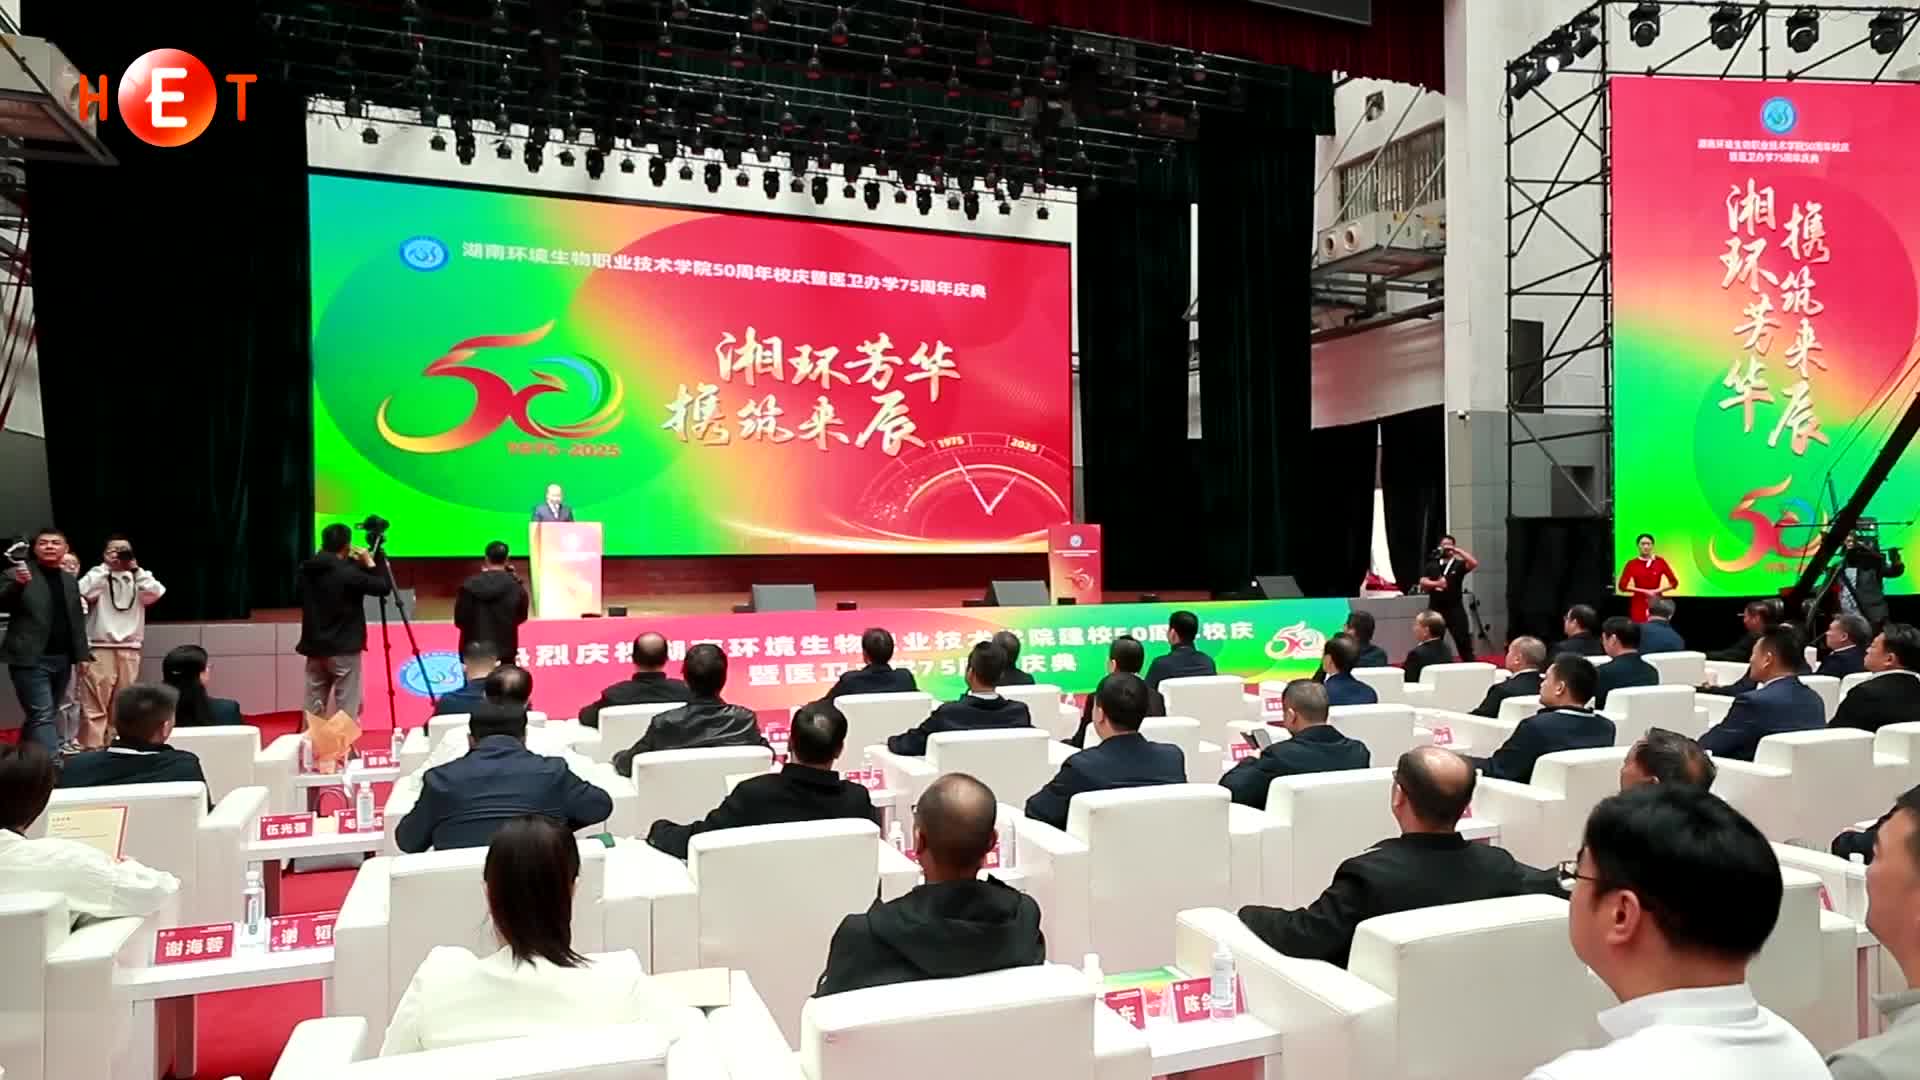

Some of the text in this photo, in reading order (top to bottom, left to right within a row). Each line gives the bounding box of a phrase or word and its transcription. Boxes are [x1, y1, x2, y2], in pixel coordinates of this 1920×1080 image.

[463, 242, 986, 299] 湖南环境生物职业技术学院50周年校庆暨医卫办学75周年庆典
[1718, 178, 1781, 432] 湘环芳华
[1768, 200, 1830, 455] 携筑来辰
[715, 326, 961, 402] 湘环芳华
[661, 382, 926, 456] 携筑来辰
[937, 436, 965, 448] 1975
[1010, 438, 1037, 452] 2025
[507, 442, 621, 457] 1975-2025
[165, 936, 225, 957] 谢海蓉
